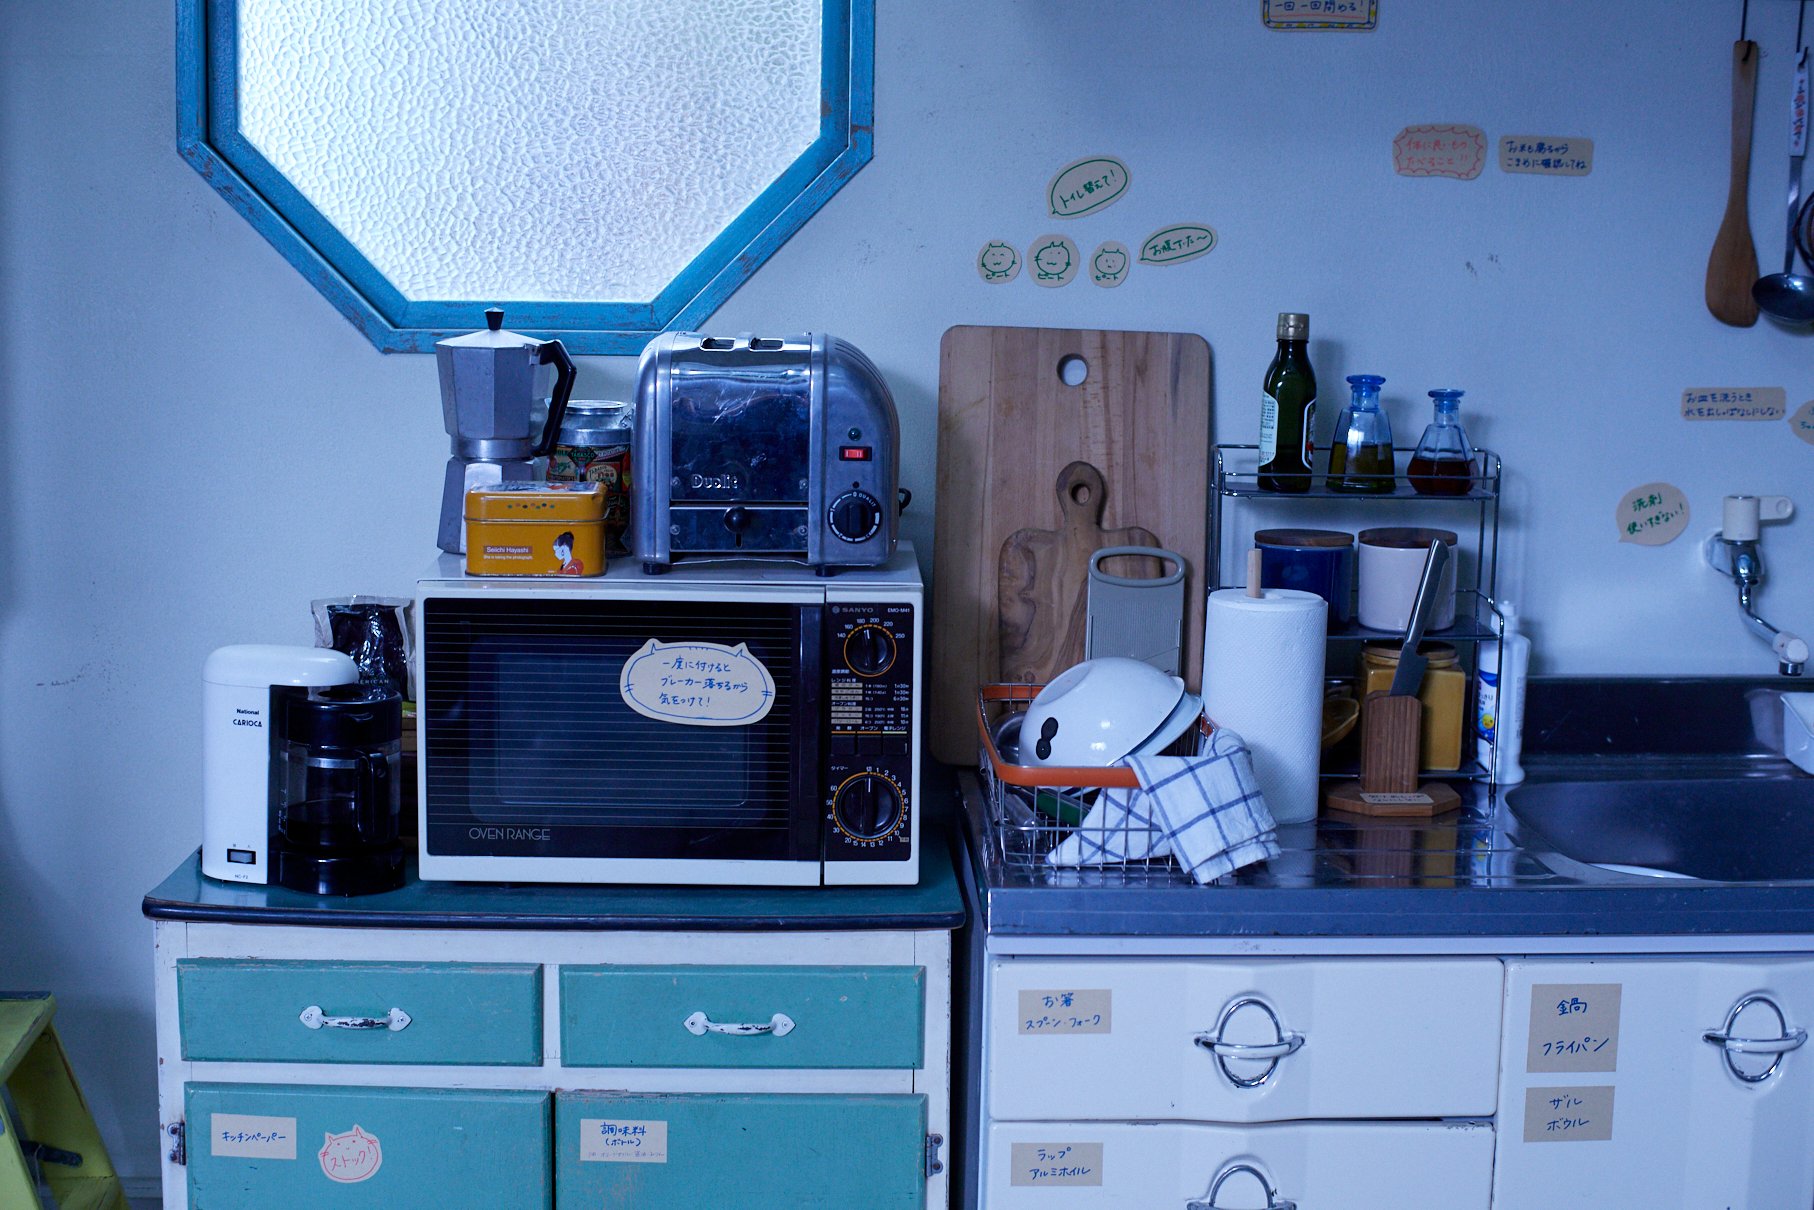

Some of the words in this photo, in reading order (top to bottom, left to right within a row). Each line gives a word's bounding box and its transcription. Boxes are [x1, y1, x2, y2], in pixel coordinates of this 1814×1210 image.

[691, 473, 738, 489] Dualit
[1632, 492, 1663, 512] 洗剤
[506, 546, 529, 554] Hayashi
[662, 655, 731, 673] 一度に付けると
[660, 675, 749, 693] ブレーカー落ちるから
[658, 692, 711, 708] 気をつけて!
[232, 719, 263, 727] CARIOCA
[468, 827, 504, 840] OVEN
[506, 828, 551, 841] RANGE
[1042, 992, 1074, 1009] お箸
[1556, 997, 1588, 1016] 鍋
[1543, 1036, 1609, 1056] フライパン
[1549, 1094, 1583, 1110] ザル
[600, 1121, 647, 1137] 調味料
[1546, 1117, 1590, 1132] ボウル
[221, 1130, 287, 1143] キッチンペーパー
[330, 1145, 374, 1171] ストック!
[1037, 1146, 1072, 1161] ラップ
[1029, 1166, 1091, 1181] アルミホイル
